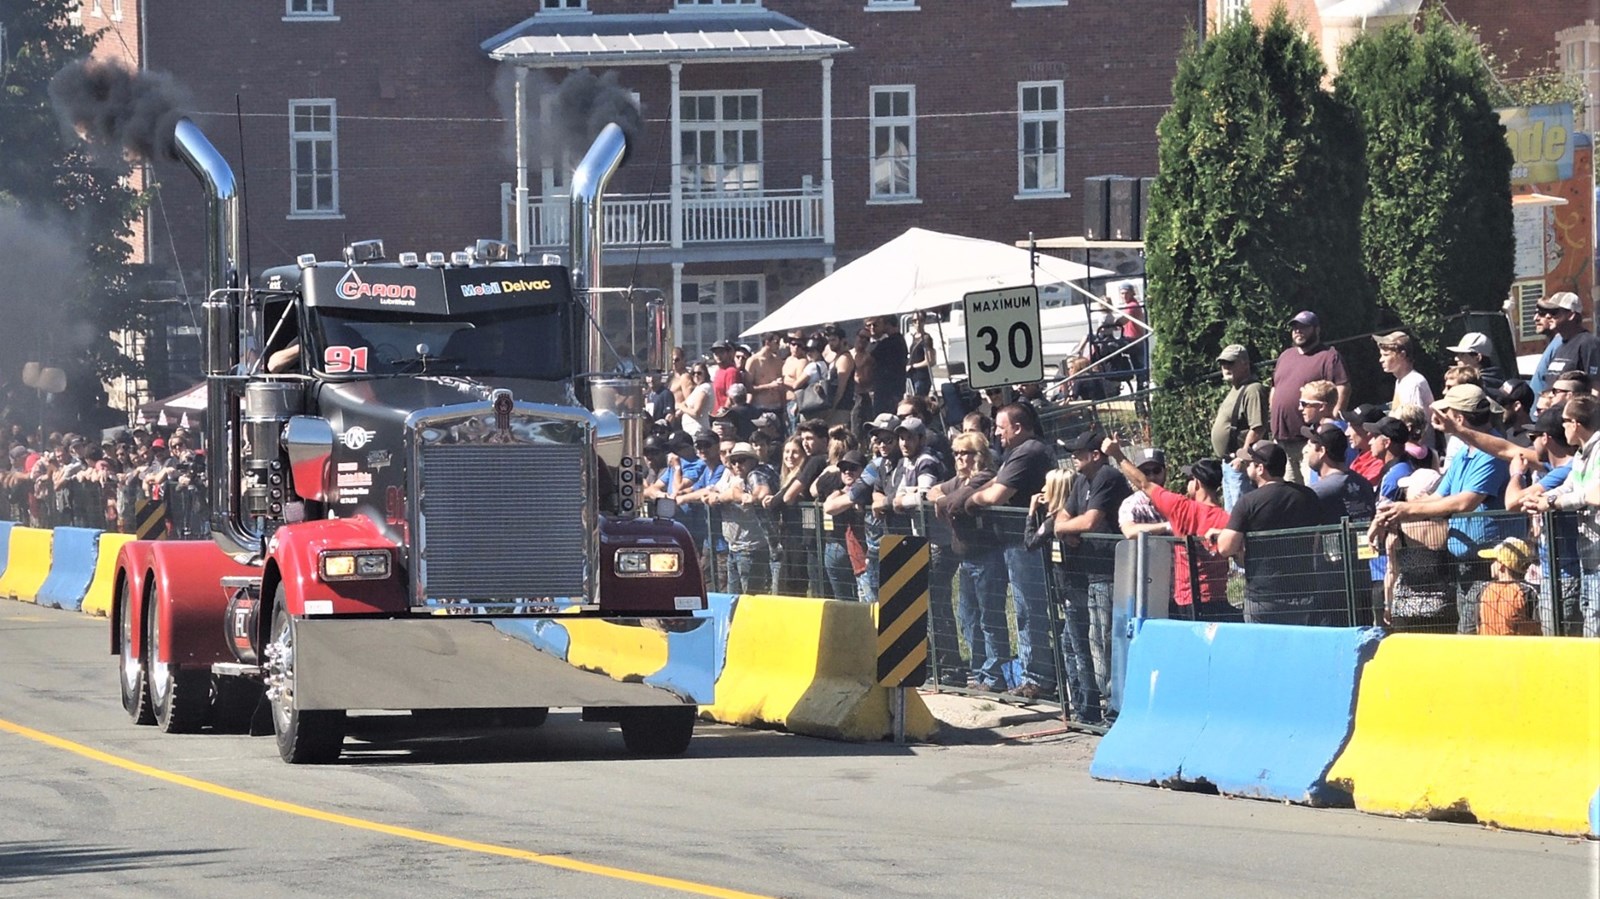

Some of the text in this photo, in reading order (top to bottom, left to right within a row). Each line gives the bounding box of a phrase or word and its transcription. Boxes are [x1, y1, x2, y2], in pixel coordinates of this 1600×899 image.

[343, 282, 416, 299] CARON
[461, 280, 551, 297] Mobil Delvac
[973, 296, 1031, 313] MAXIMUM
[976, 321, 1033, 373] 30
[324, 346, 368, 373] 91
